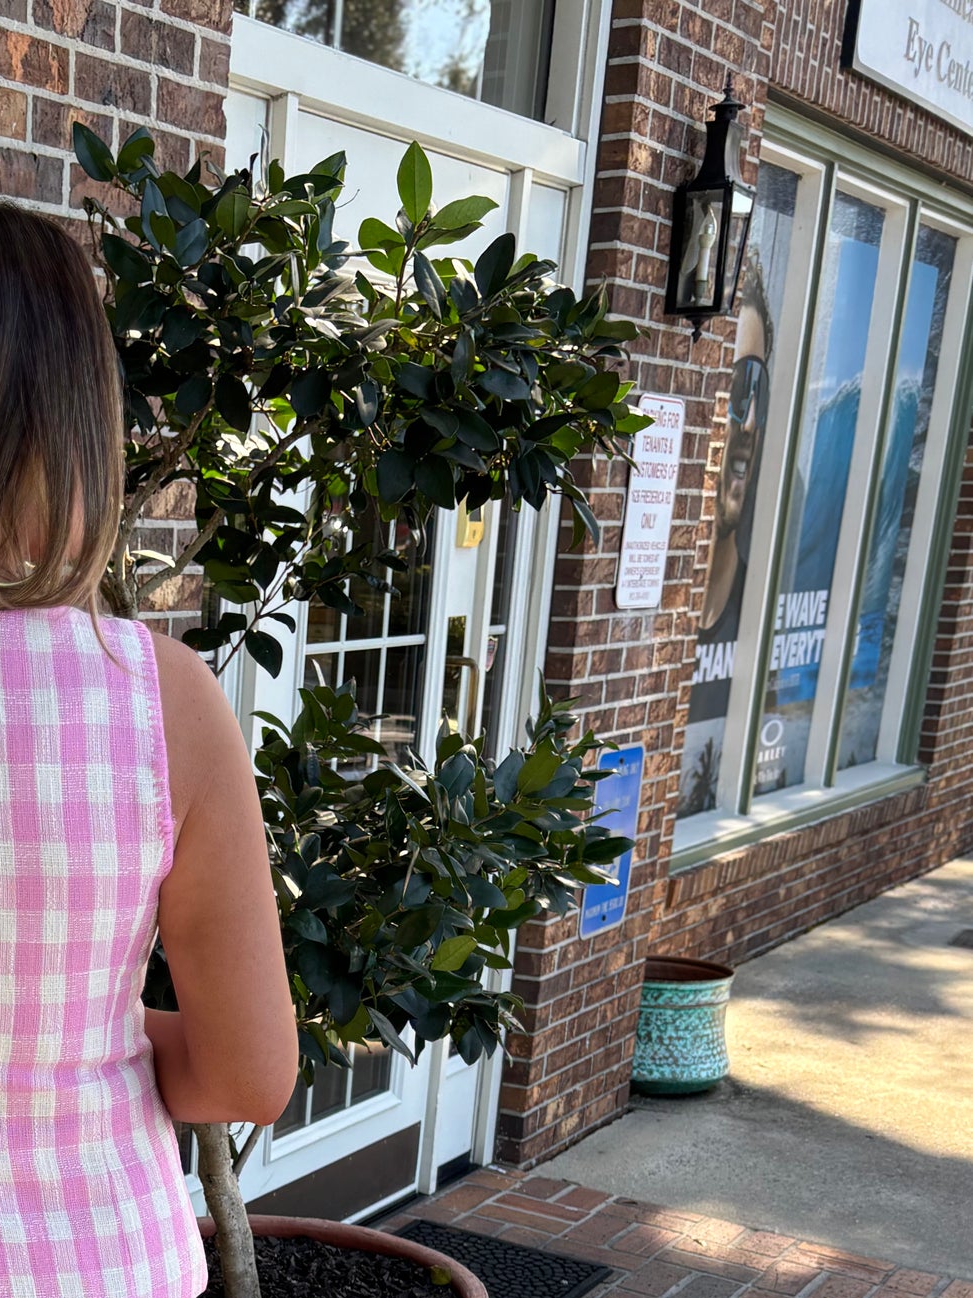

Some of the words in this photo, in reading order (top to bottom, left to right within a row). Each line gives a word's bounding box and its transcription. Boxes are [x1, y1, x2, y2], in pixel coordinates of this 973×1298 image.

[904, 16, 933, 78] Eye
[936, 40, 973, 101] Cente
[667, 411, 680, 429] FOR
[642, 435, 668, 454] TENANTS
[668, 464, 678, 480] OF
[640, 512, 657, 529] ONLY
[785, 589, 828, 629] WAVE
